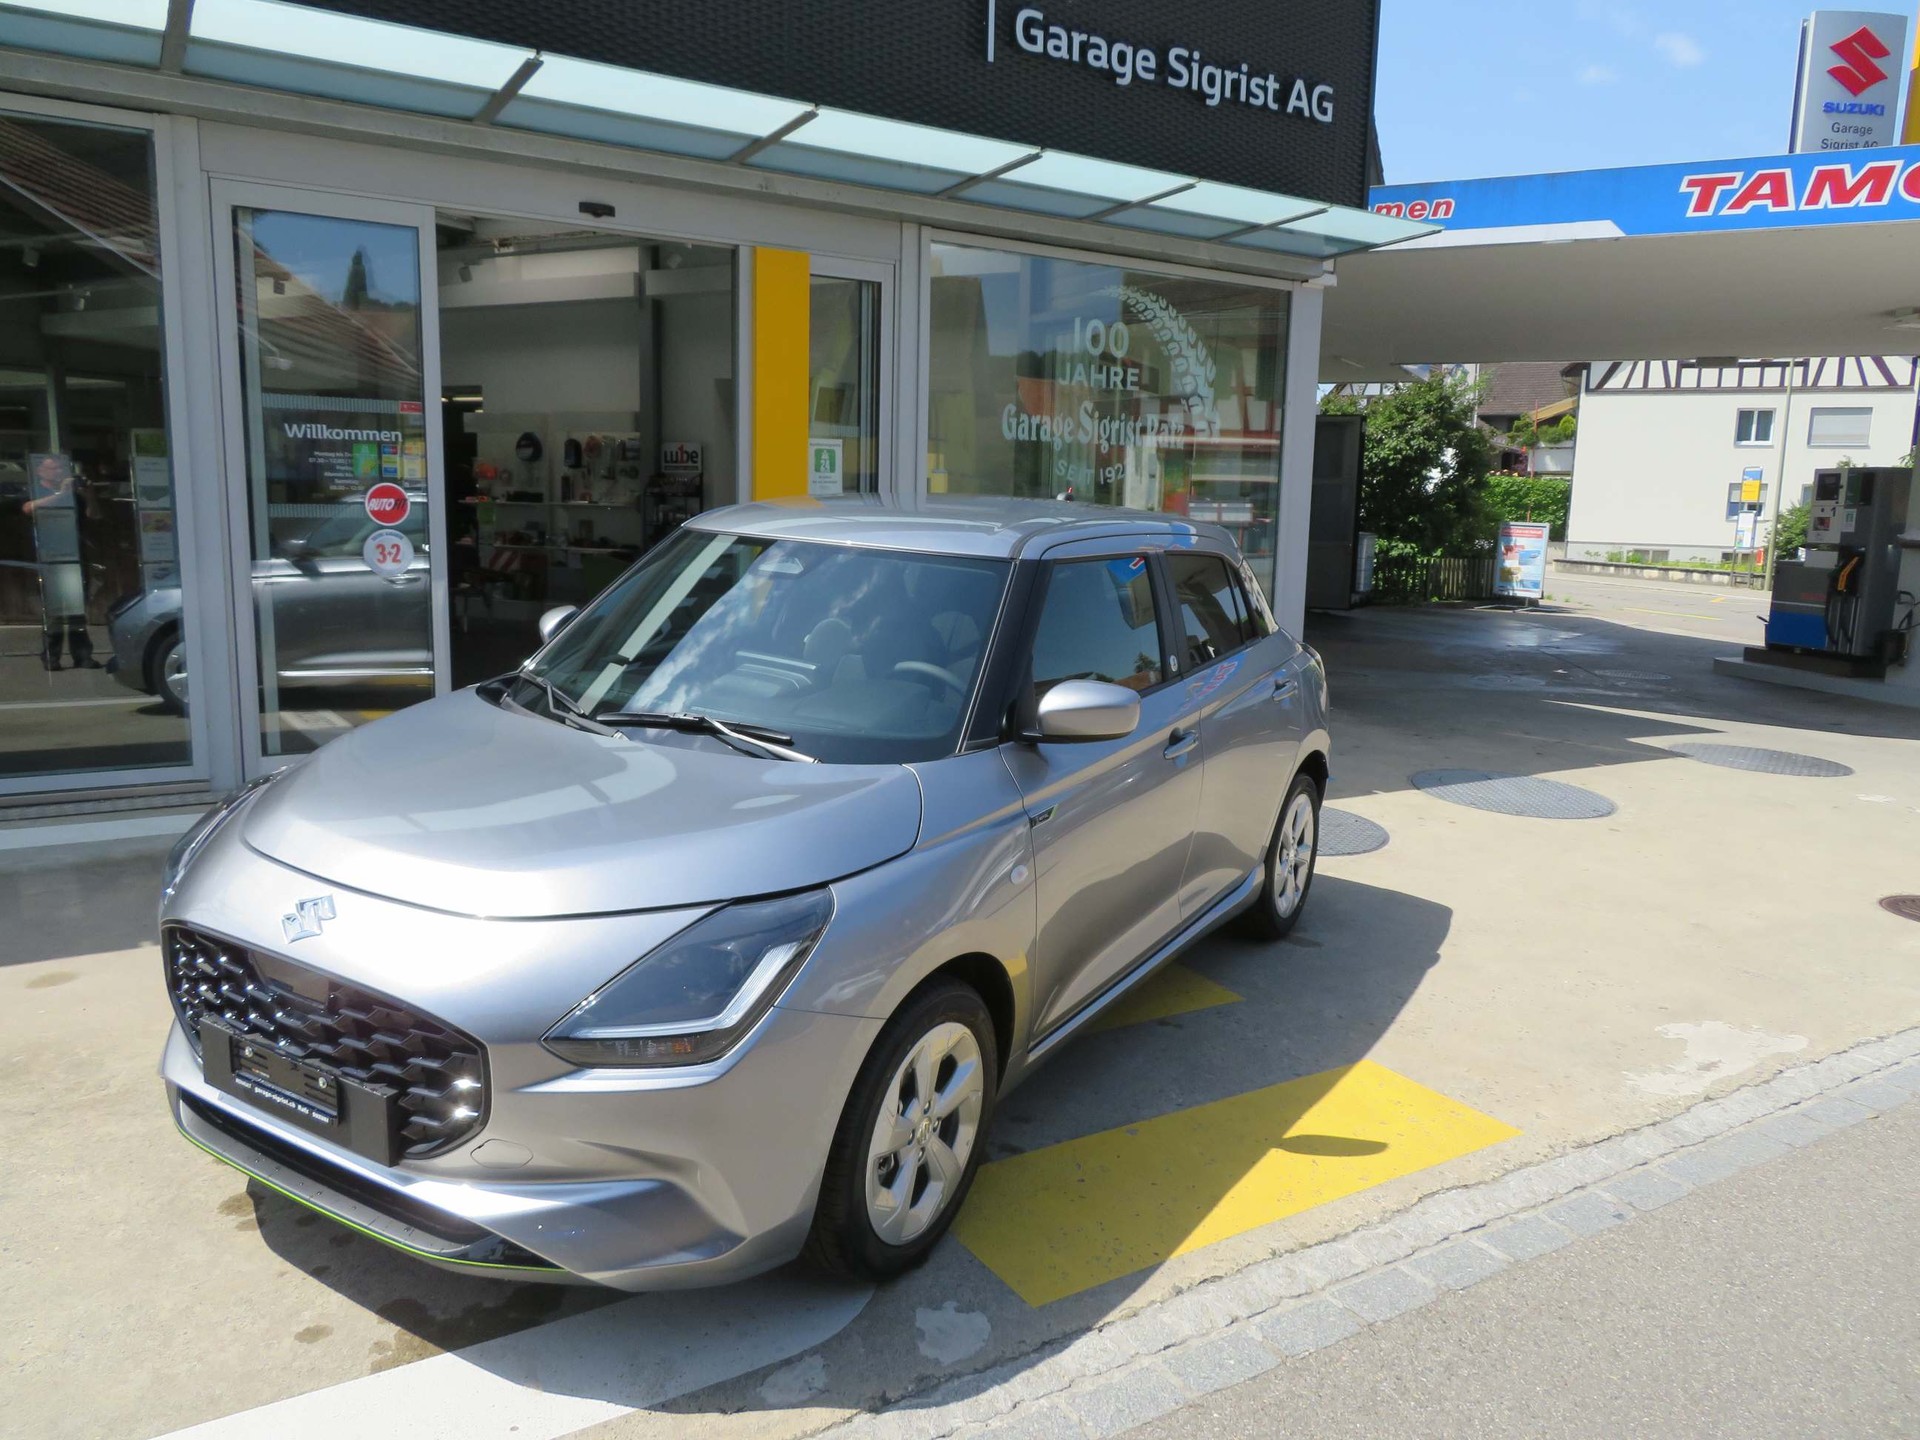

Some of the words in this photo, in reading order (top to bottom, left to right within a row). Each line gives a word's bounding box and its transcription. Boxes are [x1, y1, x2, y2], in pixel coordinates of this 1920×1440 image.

[1015, 8, 1156, 85] Garage
[1167, 47, 1280, 110] Sigrist
[1286, 79, 1334, 123] AG
[1822, 101, 1885, 116] SUZUKI
[1831, 121, 1873, 137] Garage
[1369, 198, 1455, 220] men
[1074, 317, 1130, 359] 100
[1058, 362, 1140, 391] JAHRE
[284, 423, 403, 442] Willkommen
[1001, 403, 1074, 451] Garage
[1078, 400, 1143, 454] Sigrist
[1056, 459, 1094, 485] SEIT
[1100, 462, 1129, 485] 192
